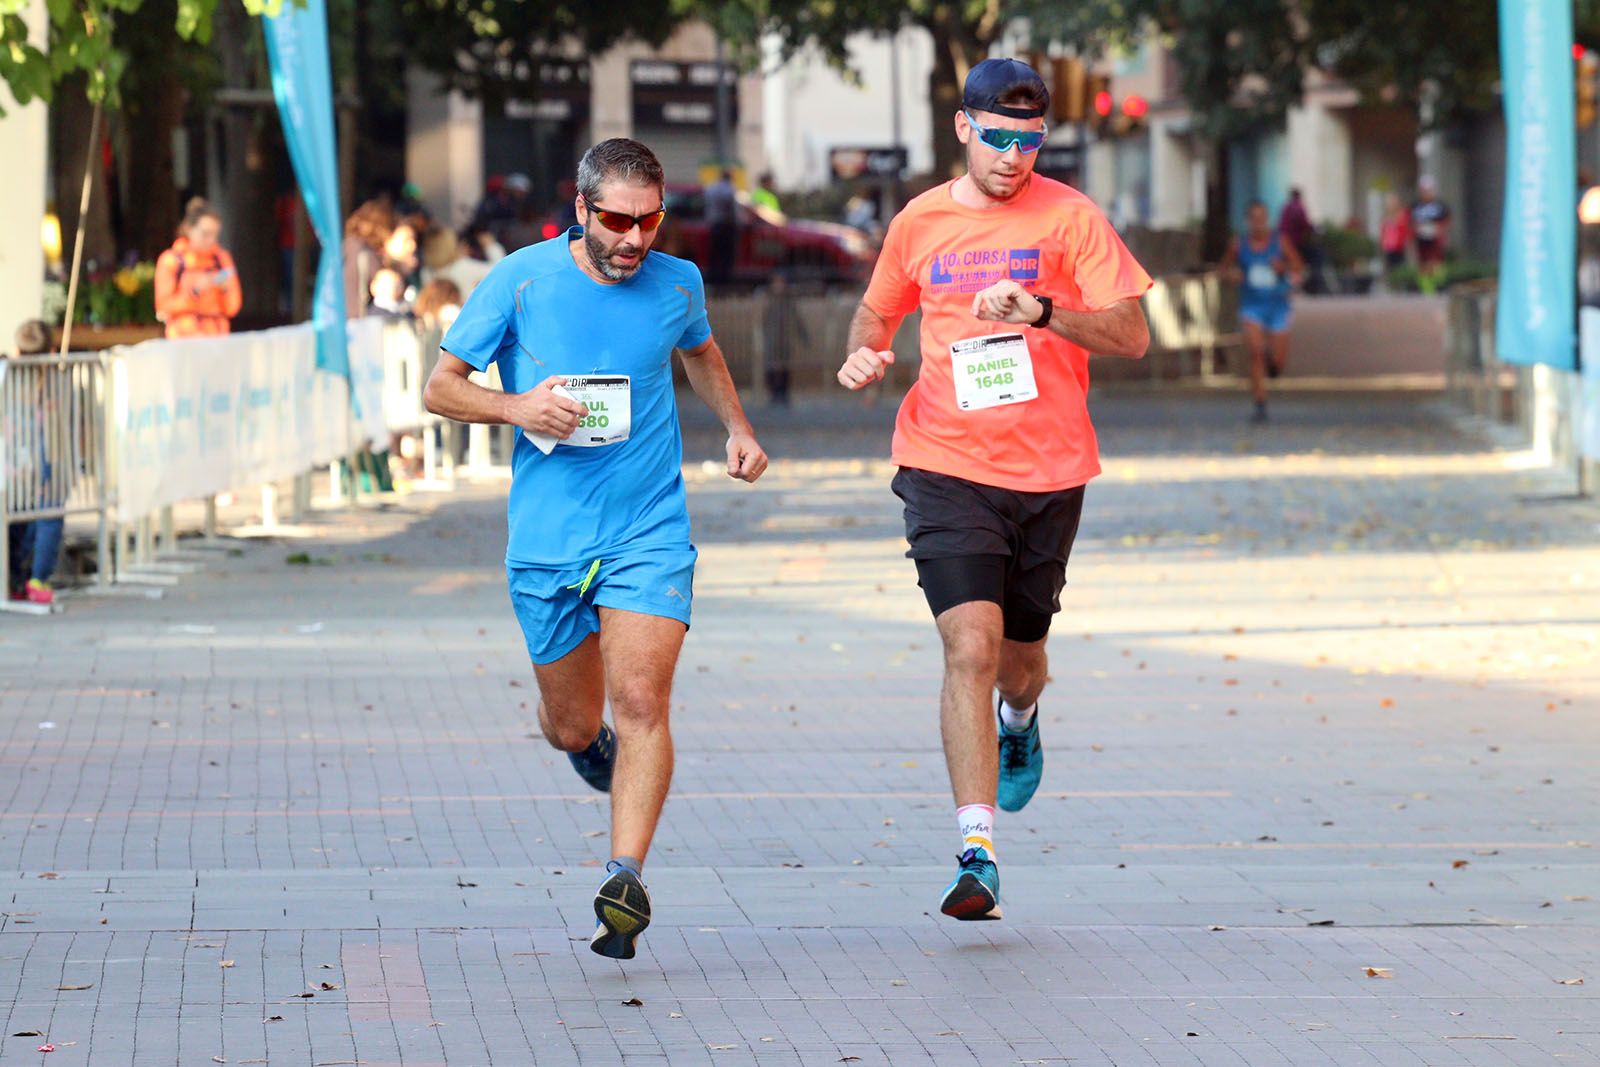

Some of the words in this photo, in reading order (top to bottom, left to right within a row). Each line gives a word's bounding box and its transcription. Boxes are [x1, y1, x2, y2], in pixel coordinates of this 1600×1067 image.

[963, 249, 1007, 266] CURSA
[967, 358, 1018, 375] DANIEL
[975, 372, 1014, 389] 1648
[581, 401, 609, 412] AUL
